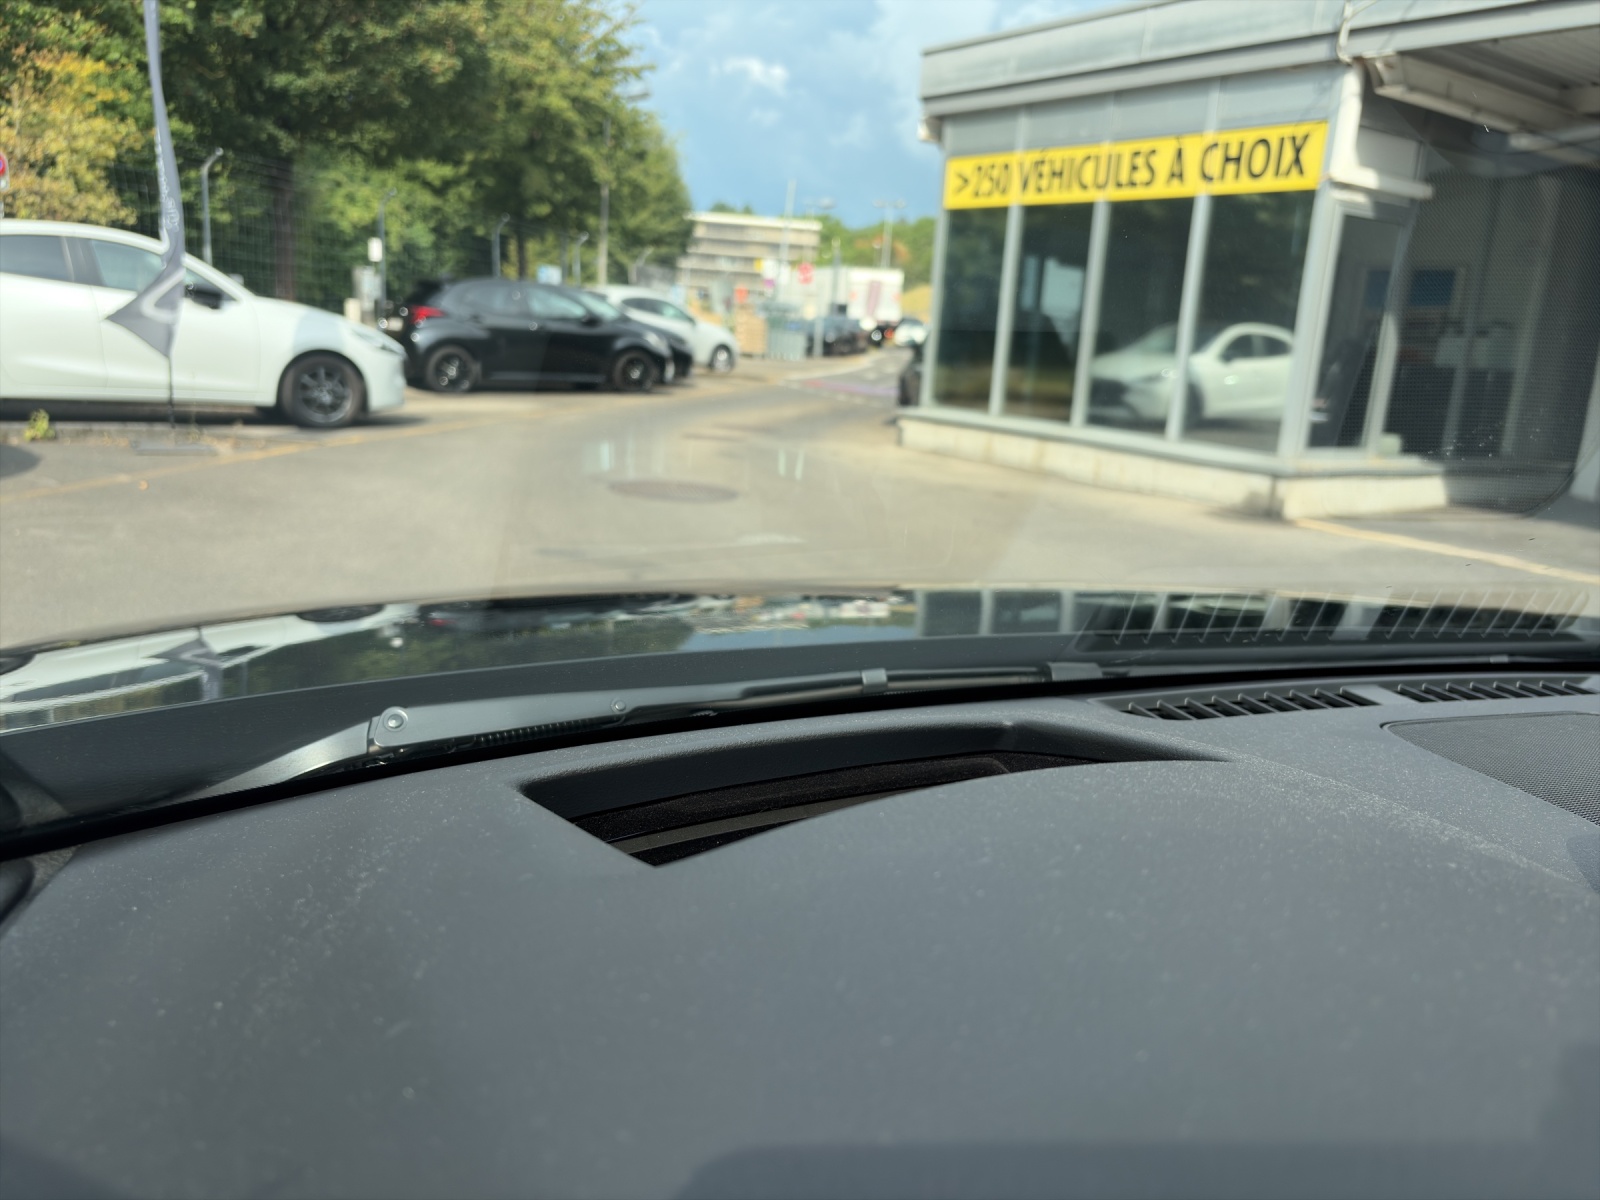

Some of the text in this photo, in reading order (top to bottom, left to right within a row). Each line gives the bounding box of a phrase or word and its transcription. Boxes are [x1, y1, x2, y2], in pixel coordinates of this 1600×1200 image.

[954, 133, 1310, 198] >250 VÉHICULES À CHOIX
